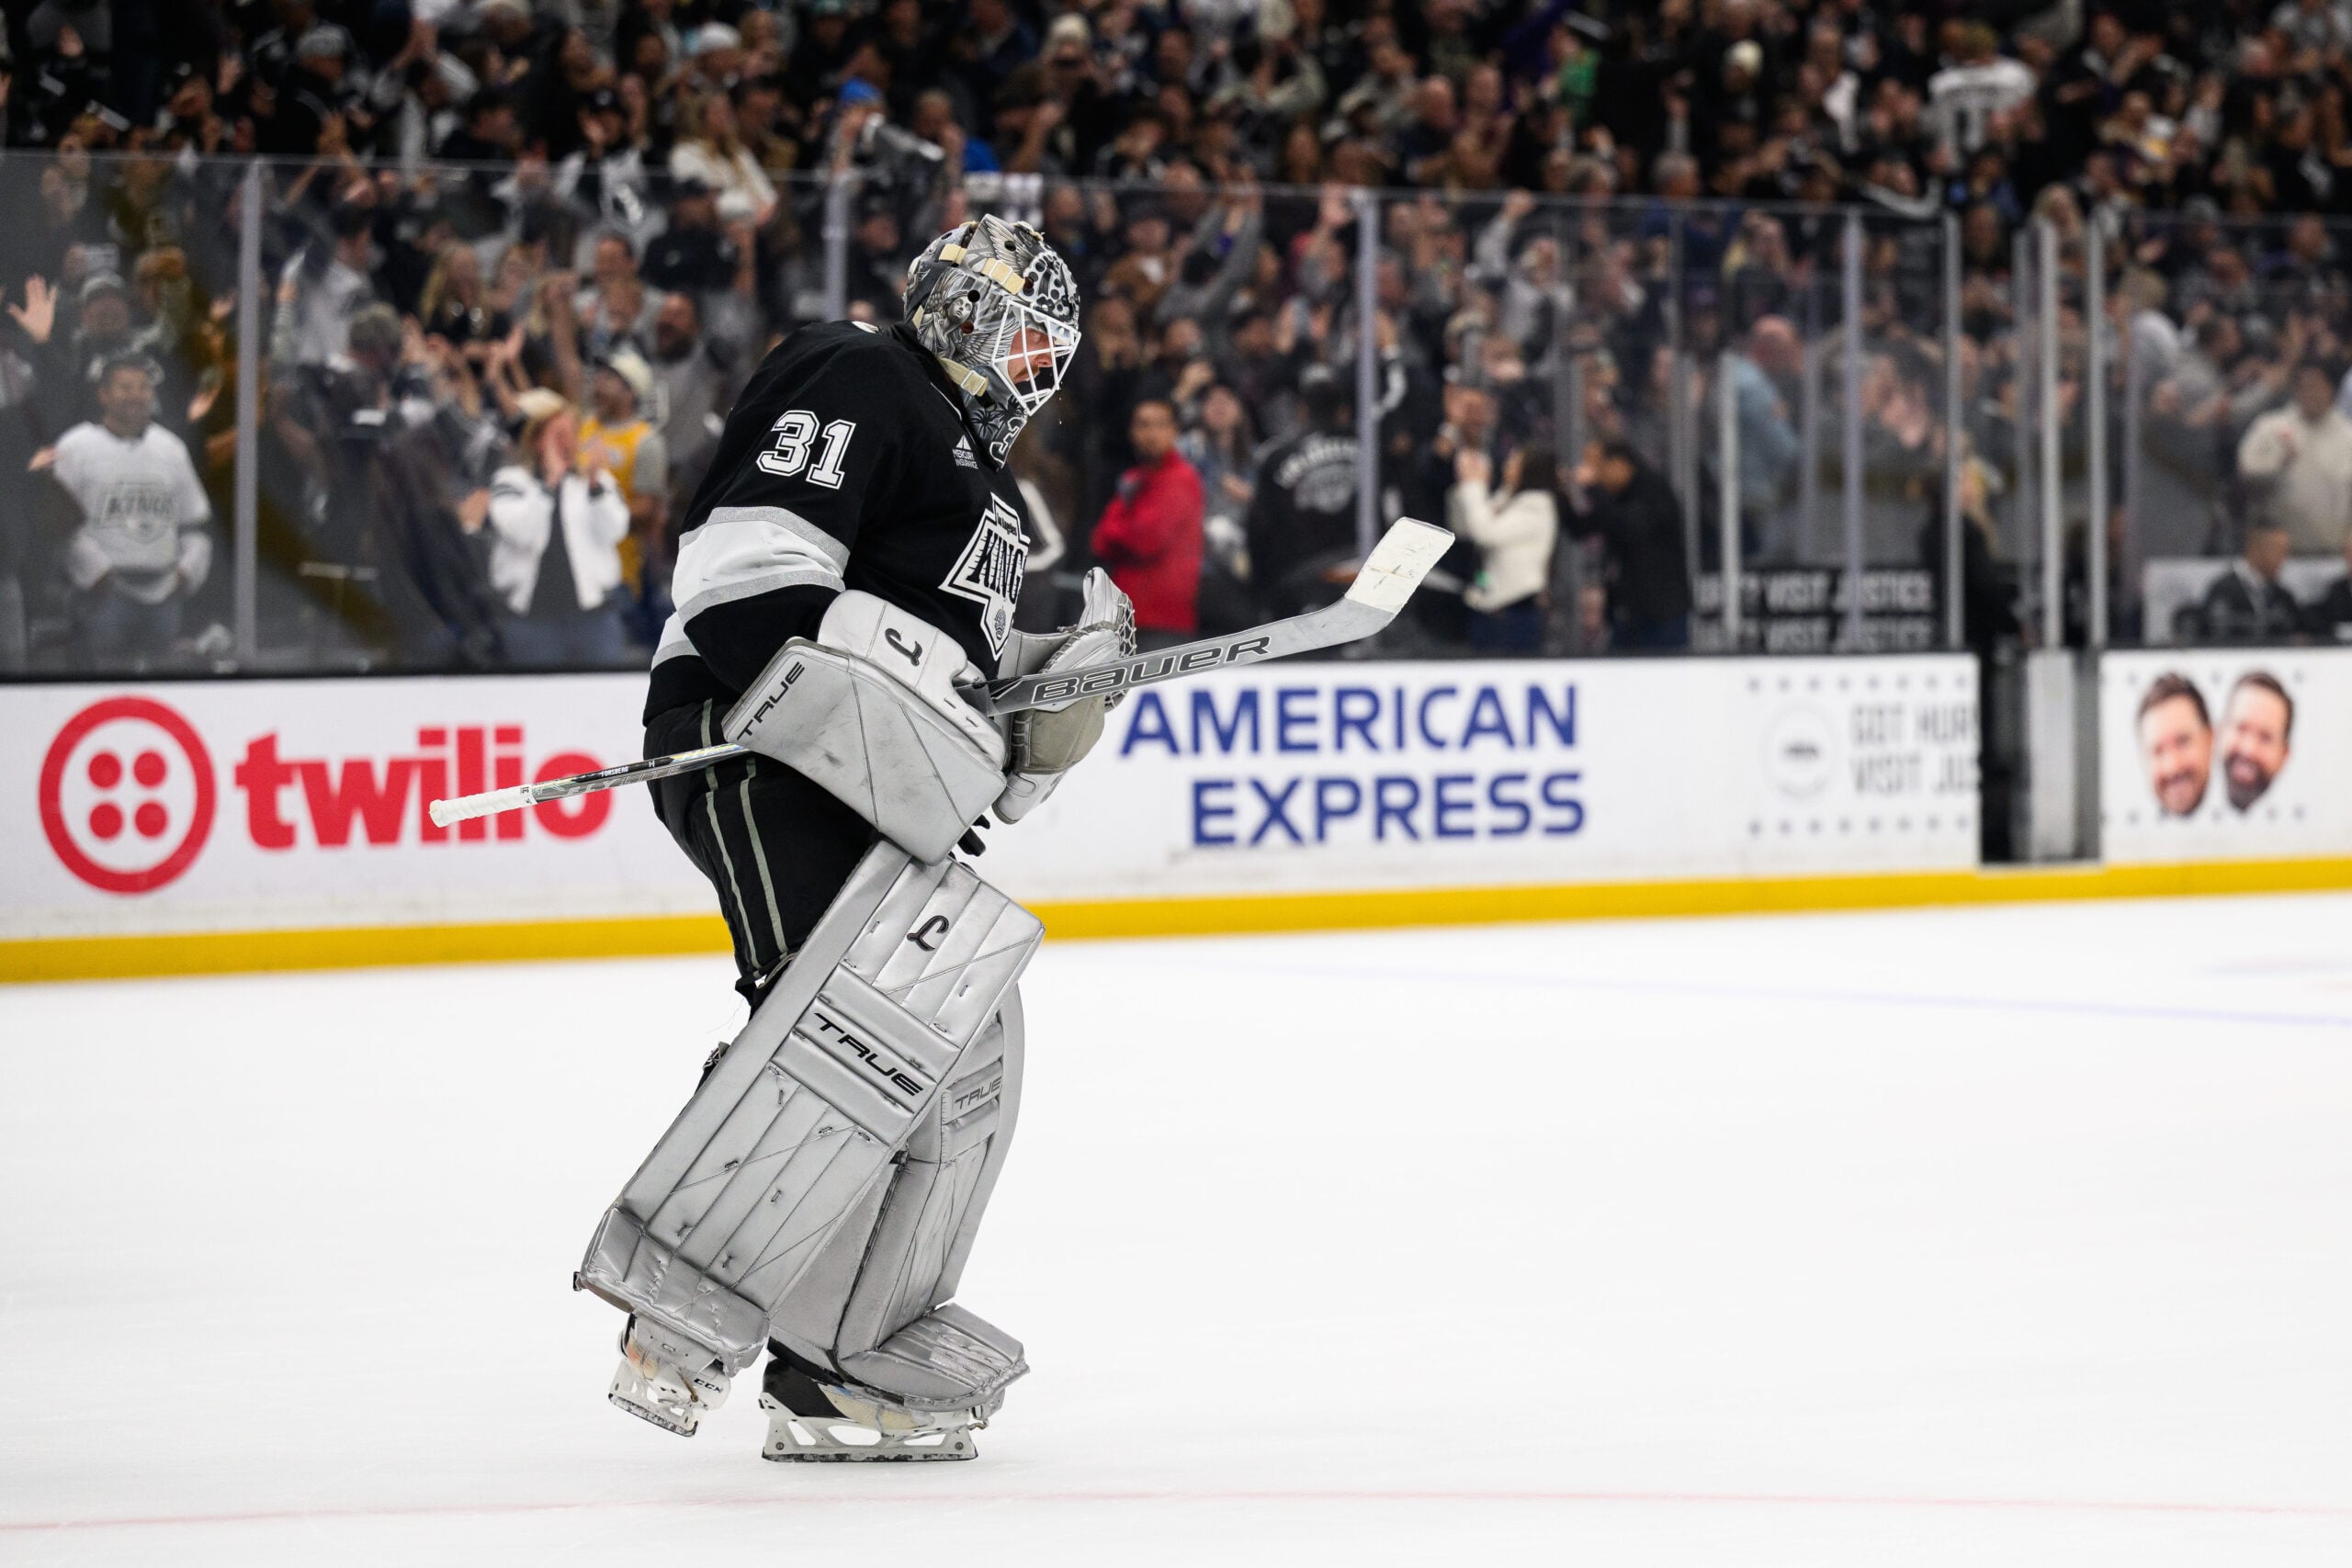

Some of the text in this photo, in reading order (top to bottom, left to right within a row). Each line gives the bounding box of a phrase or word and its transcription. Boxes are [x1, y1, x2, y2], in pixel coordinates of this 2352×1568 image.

[756, 410, 856, 490] 31
[966, 529, 1026, 604] KING
[737, 661, 805, 740] TRUE
[1030, 636, 1271, 705] BAUER
[1121, 685, 1577, 756] AMERICAN
[1849, 704, 1904, 745] GOT
[236, 725, 614, 850] twilio
[600, 765, 629, 778] FORSBERG
[1850, 753, 1921, 795] VISIT
[1193, 772, 1585, 845] EXPRESS
[814, 1012, 923, 1097] TRUE
[955, 1076, 1002, 1110] TRUE
[694, 1378, 724, 1393] CCM
